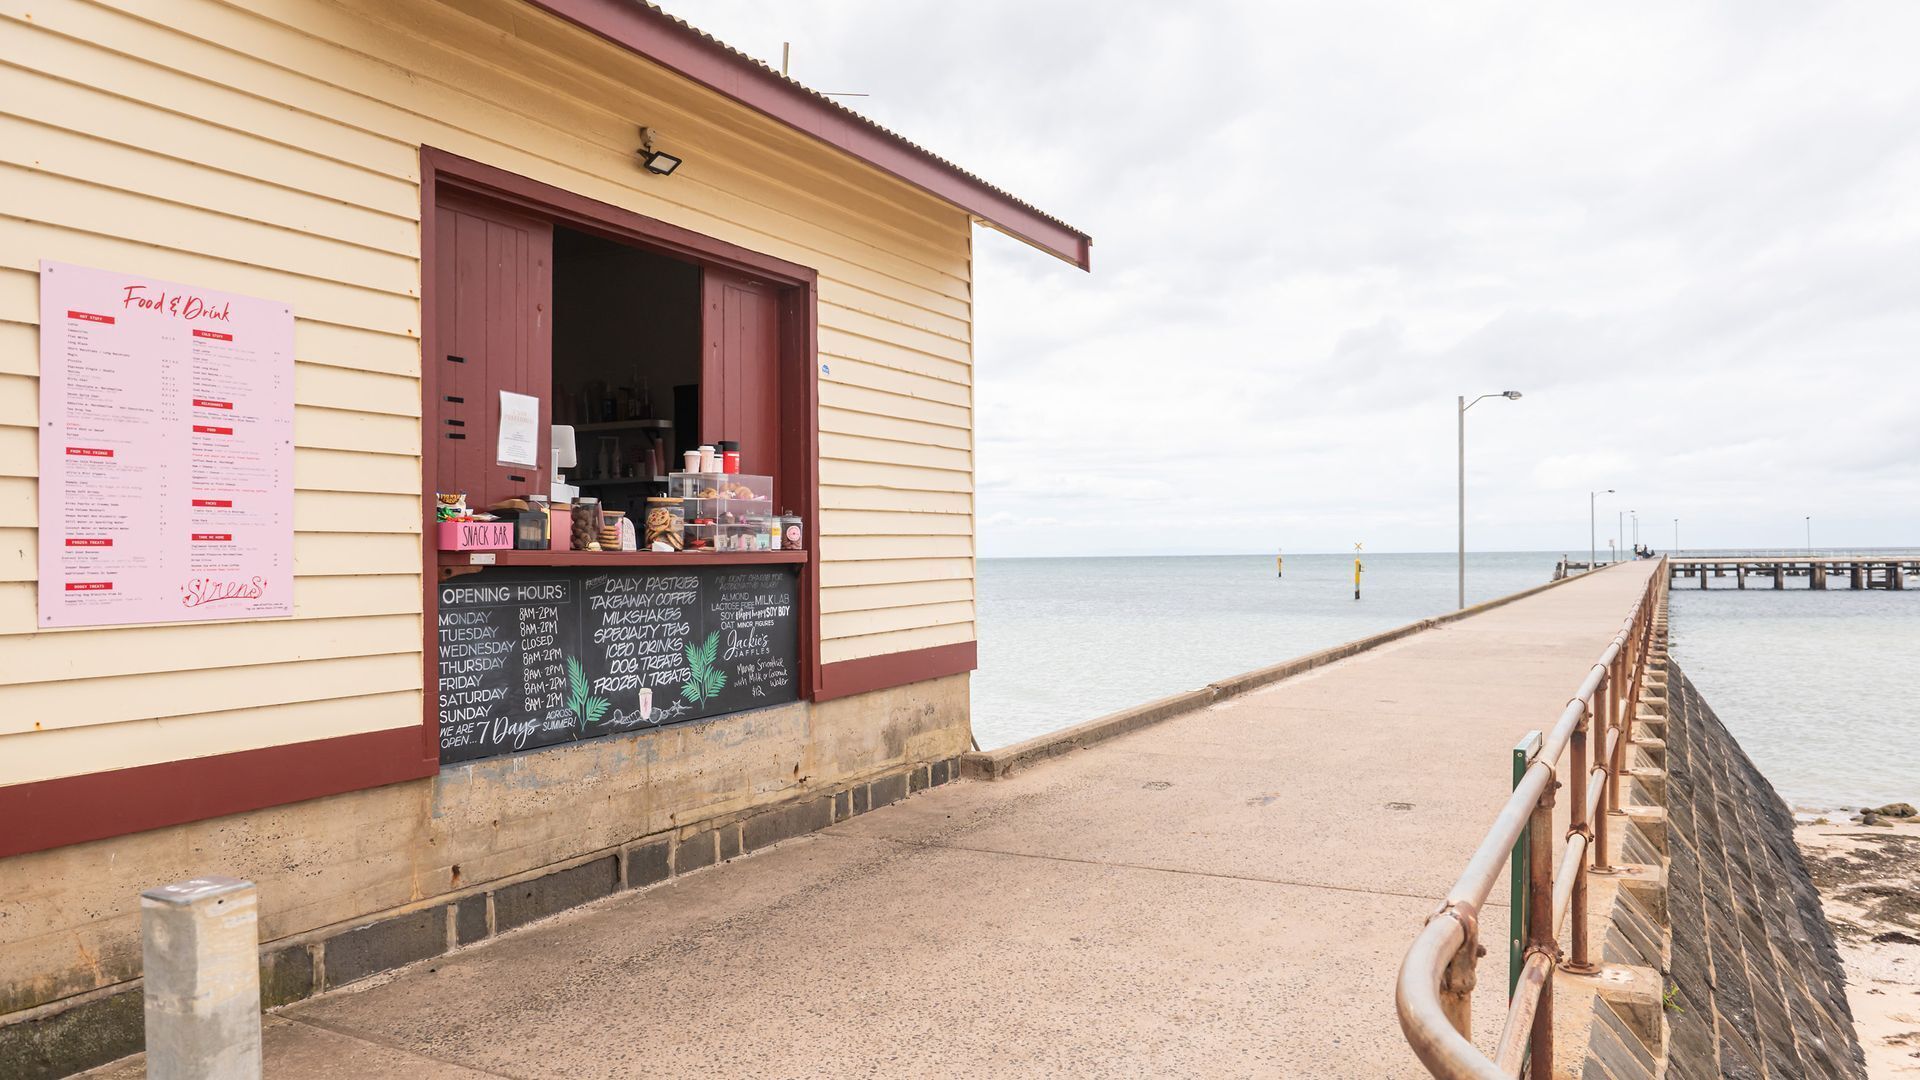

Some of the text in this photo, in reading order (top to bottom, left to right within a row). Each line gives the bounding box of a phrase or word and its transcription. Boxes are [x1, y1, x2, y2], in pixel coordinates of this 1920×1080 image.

[123, 285, 230, 322] Food & Drink
[462, 525, 509, 547] SNACK BAR
[442, 585, 567, 604] OPENING HOURS:
[604, 577, 643, 593] DAILY
[645, 576, 699, 591] PASTRIES
[589, 591, 697, 610] TAKEAWAY COFFEE
[711, 601, 755, 612] LACTOSE FREE
[720, 592, 750, 602] ALMOND
[438, 606, 559, 627] MONDAY 8AM-2PM
[602, 607, 682, 626] MILKSHAKES
[720, 611, 736, 621] SOY
[766, 606, 778, 618] SOY
[777, 605, 791, 617] BOY
[439, 620, 558, 642] TUESDAY 8AM-2PM
[594, 622, 690, 644] SPECIALTY TEAS
[720, 619, 775, 631] OAT MINOR FIGURES
[439, 635, 554, 658] WEDNESDAY CLOSED
[605, 637, 684, 660] ICED DRINKS
[723, 626, 769, 661] Jackie's
[734, 647, 770, 658] JAFFLES
[439, 648, 562, 675] THURSDAY 8AM-2PM
[610, 653, 683, 674] DOG TREATS
[439, 674, 484, 692] FRIDAY
[593, 667, 692, 695] FROZEN TREATS
[439, 677, 567, 708] SATURDAY 8AM-2PM
[439, 704, 493, 724] SUNDAY
[541, 716, 577, 732] SUMMER!
[545, 708, 573, 720] ACROSS
[439, 723, 475, 738] WE ARE
[476, 720, 490, 744] 7
[492, 716, 541, 750] Days
